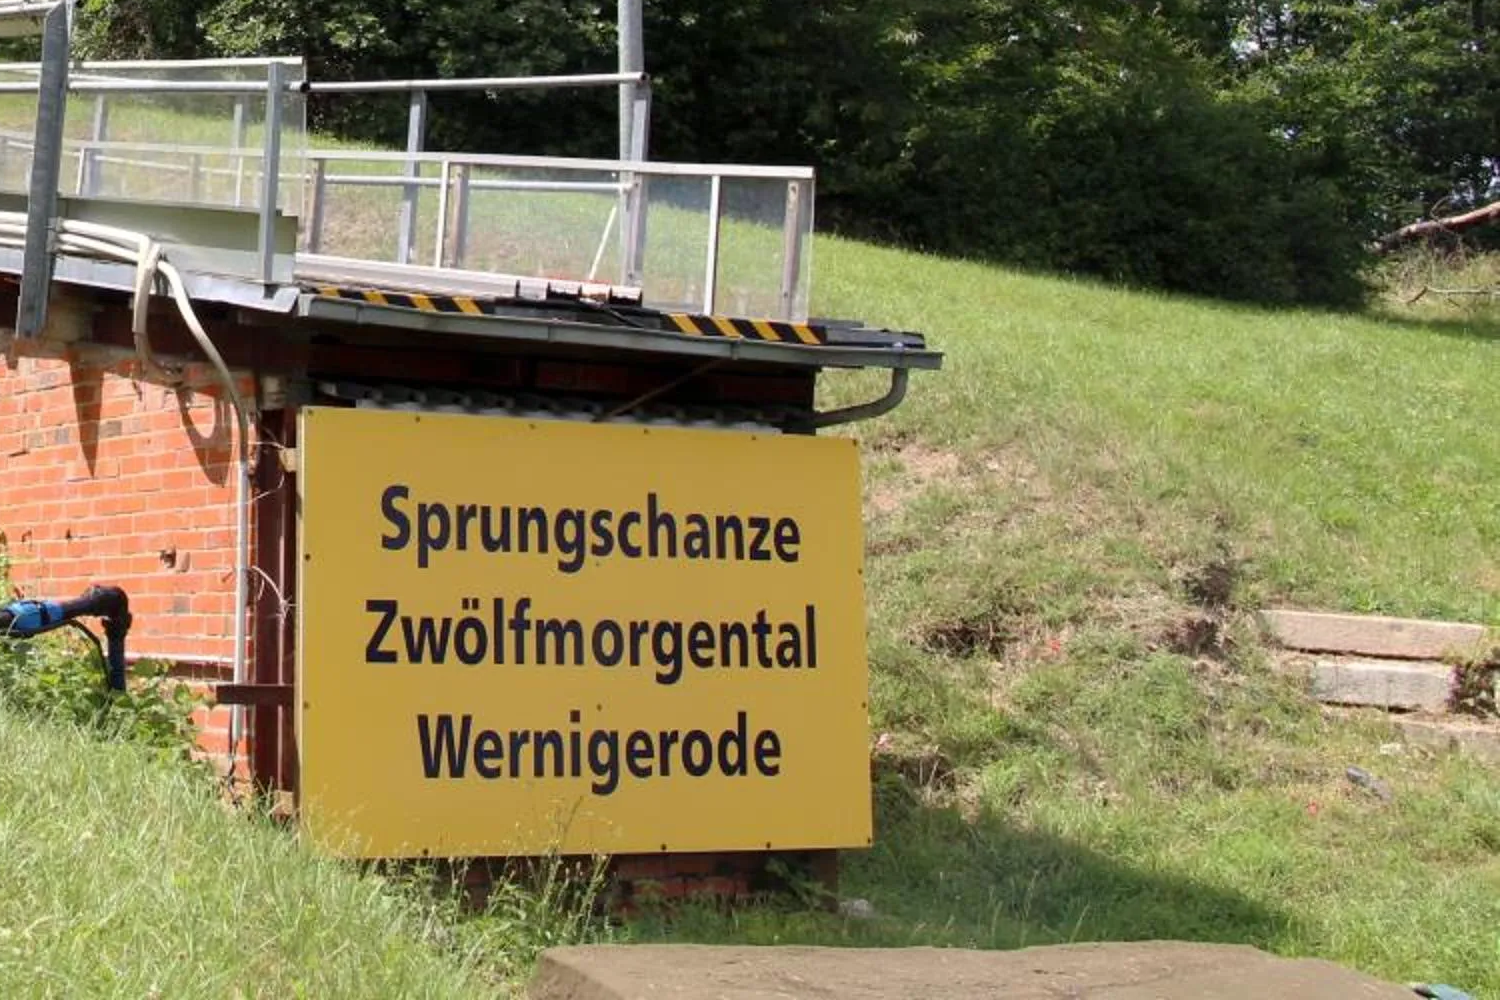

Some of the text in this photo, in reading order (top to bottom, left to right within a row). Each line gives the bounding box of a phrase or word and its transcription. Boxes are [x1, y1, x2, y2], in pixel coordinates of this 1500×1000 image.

[380, 485, 802, 574] Sprungschanze
[365, 596, 817, 686] Zwölfmorgental
[417, 710, 781, 797] Wernigerode
